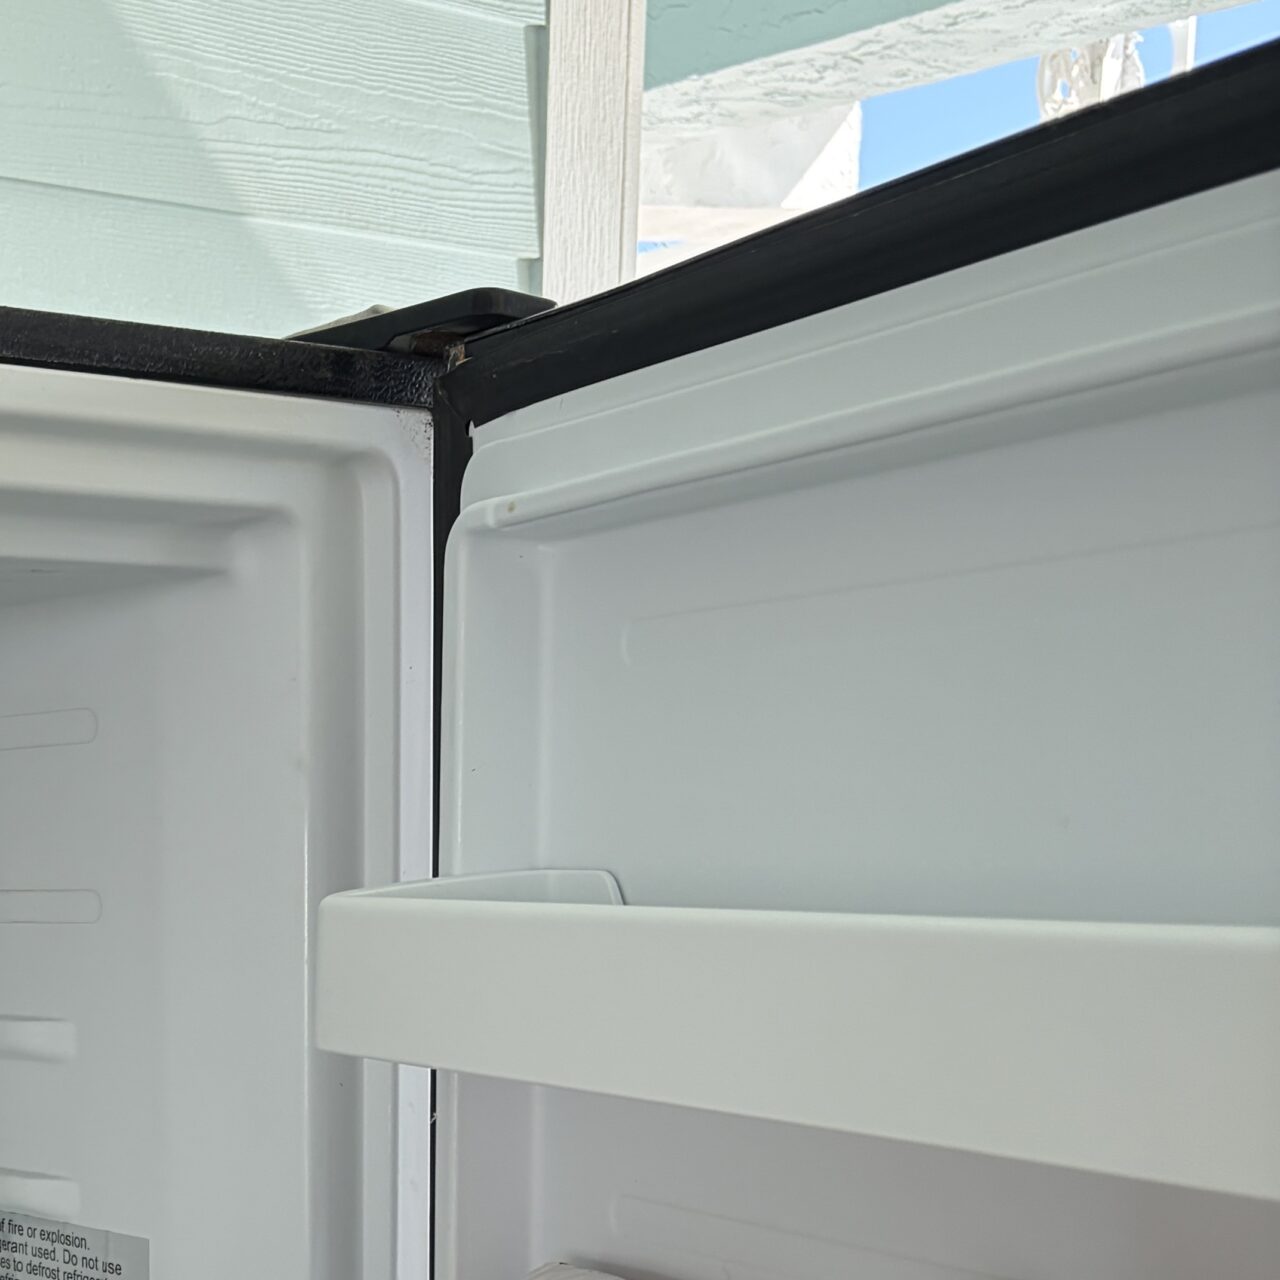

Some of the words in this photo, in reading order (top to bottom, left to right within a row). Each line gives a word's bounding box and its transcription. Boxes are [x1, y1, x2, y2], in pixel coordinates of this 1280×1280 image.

[8, 1219, 24, 1236] fire
[26, 1226, 38, 1239] or
[39, 1229, 90, 1250] explosion.
[12, 1257, 24, 1273] to
[30, 1244, 59, 1262] used.
[62, 1248, 78, 1267] Do
[80, 1256, 99, 1272] not
[101, 1261, 122, 1276] use
